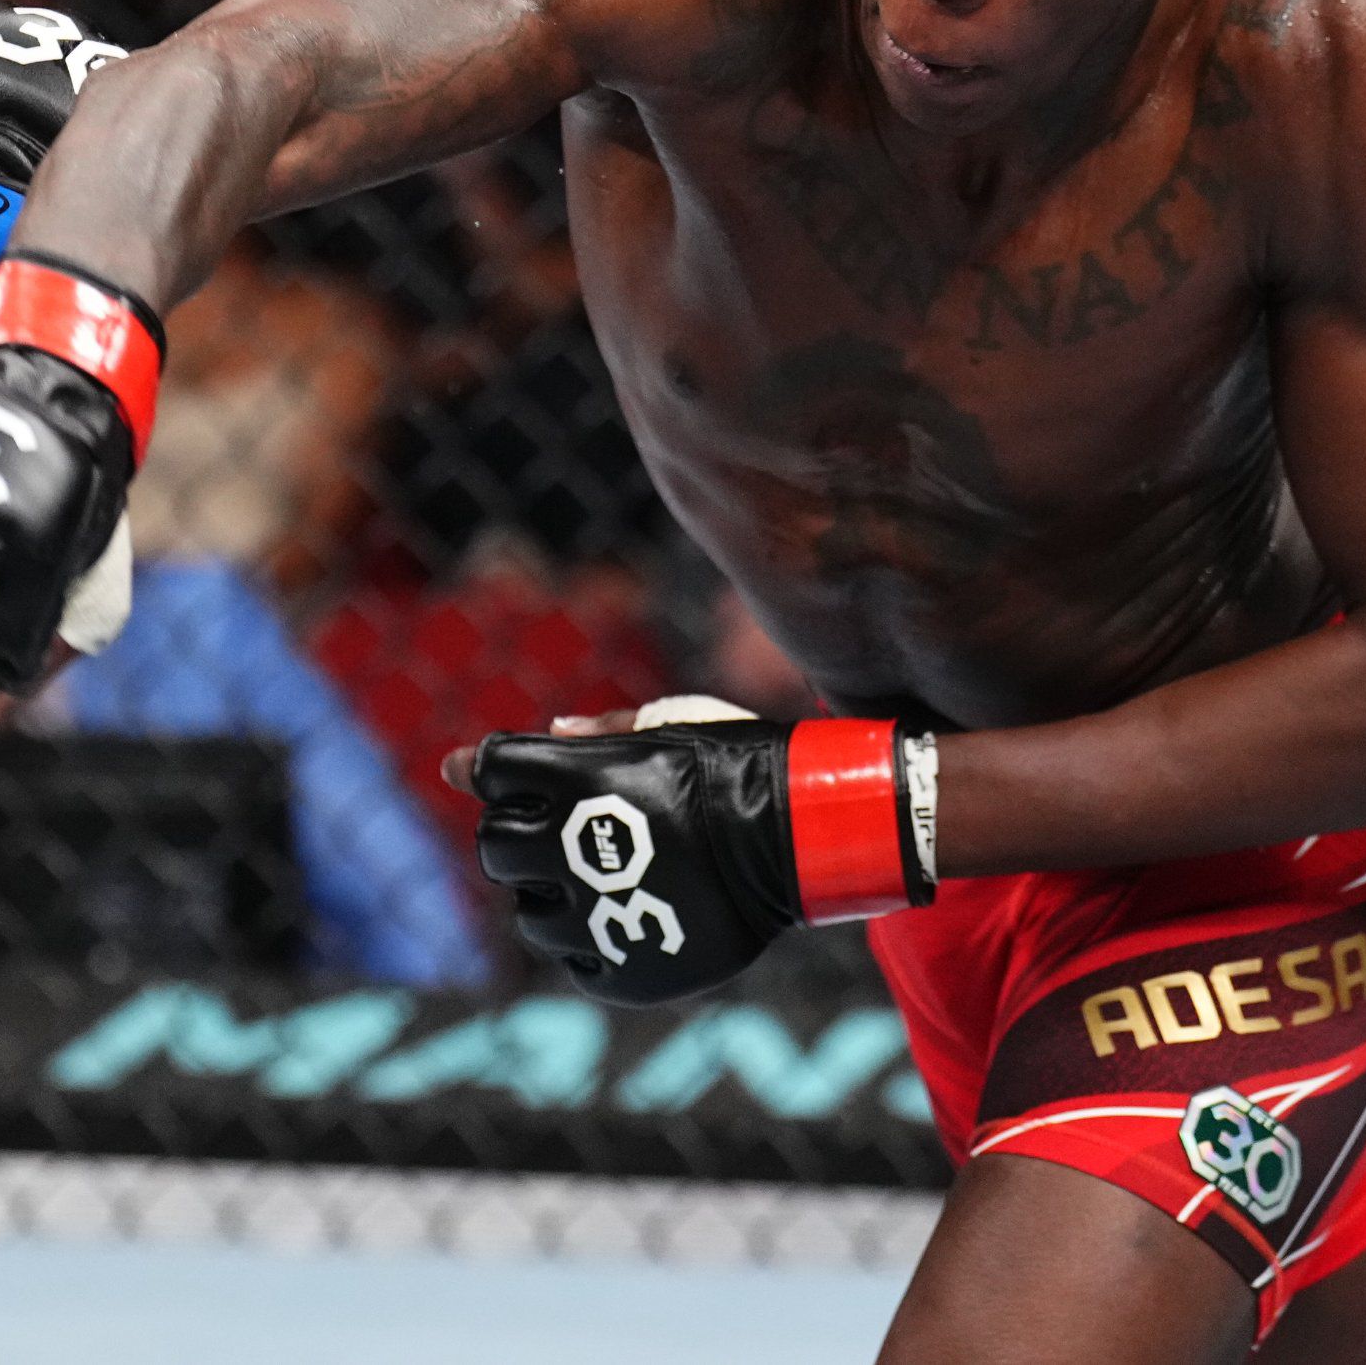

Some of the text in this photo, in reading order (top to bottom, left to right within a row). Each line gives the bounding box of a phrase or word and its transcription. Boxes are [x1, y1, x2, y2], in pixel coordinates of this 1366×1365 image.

[561, 793, 686, 966] 30
[591, 818, 623, 870] UFC
[1198, 1103, 1291, 1208] 30
